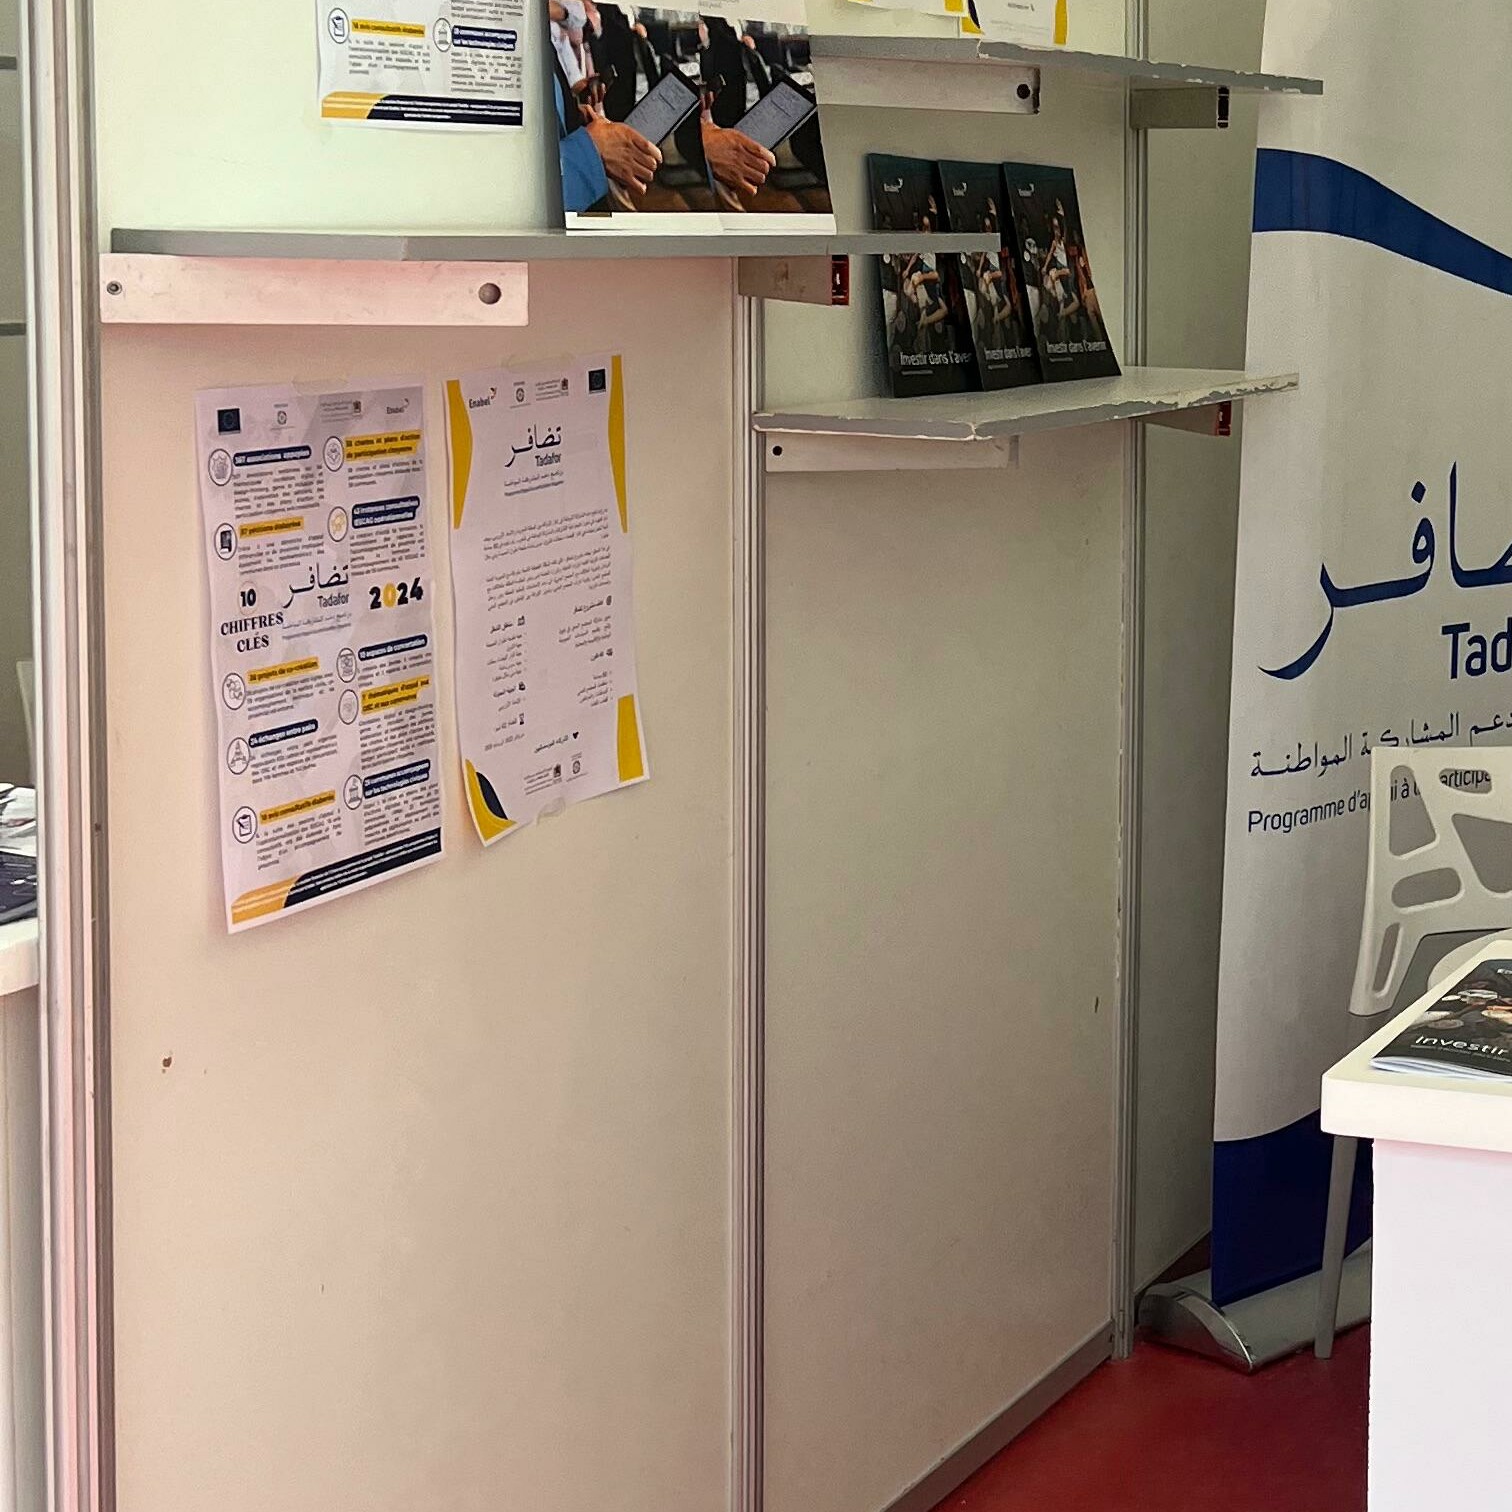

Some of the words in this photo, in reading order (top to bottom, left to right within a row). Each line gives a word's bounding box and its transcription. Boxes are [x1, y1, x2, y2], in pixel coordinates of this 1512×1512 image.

[468, 396, 491, 409] Enabel
[504, 423, 562, 468] تضافر
[534, 452, 562, 467] Tadafor
[282, 562, 350, 609] تضافر
[369, 576, 424, 610] 2024
[240, 588, 257, 607] 10
[317, 593, 349, 609] Tadafor
[220, 611, 284, 636] CHIFFRES
[236, 632, 270, 653] CLÉS
[1250, 733, 1352, 778] المواطنة
[1248, 803, 1345, 835] Programme
[1415, 1035, 1509, 1057] Investir
